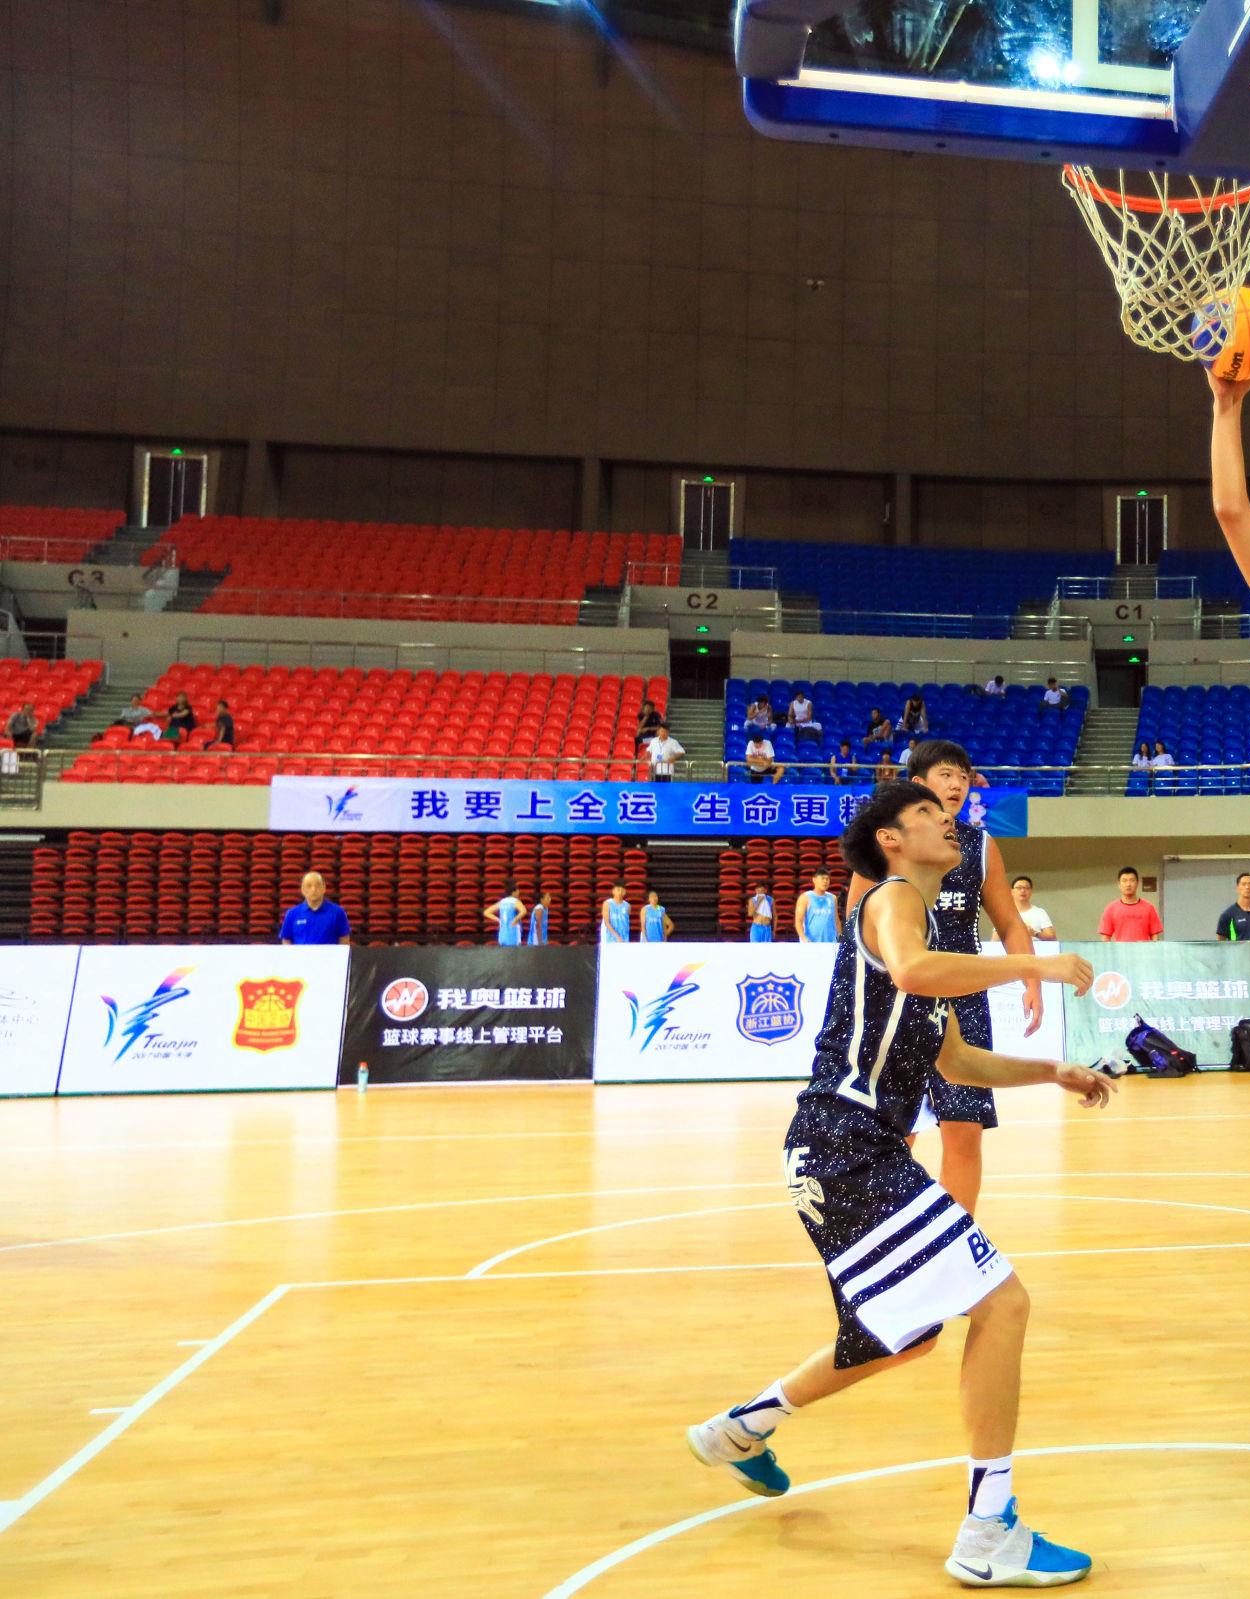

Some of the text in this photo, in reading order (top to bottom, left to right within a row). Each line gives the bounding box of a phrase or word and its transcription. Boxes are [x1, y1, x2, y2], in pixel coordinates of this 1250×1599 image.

[686, 593, 718, 609] C2
[1115, 604, 1143, 620] C1
[410, 789, 657, 824] 我要上全运
[933, 891, 966, 911] 学生
[437, 987, 567, 1010] 我奥篮球
[1138, 979, 1249, 1000] 我奥篮球
[143, 1033, 198, 1050] Tianjin
[382, 1026, 564, 1046] 篮球赛事线上管理平台
[663, 1026, 712, 1042] Tianjin
